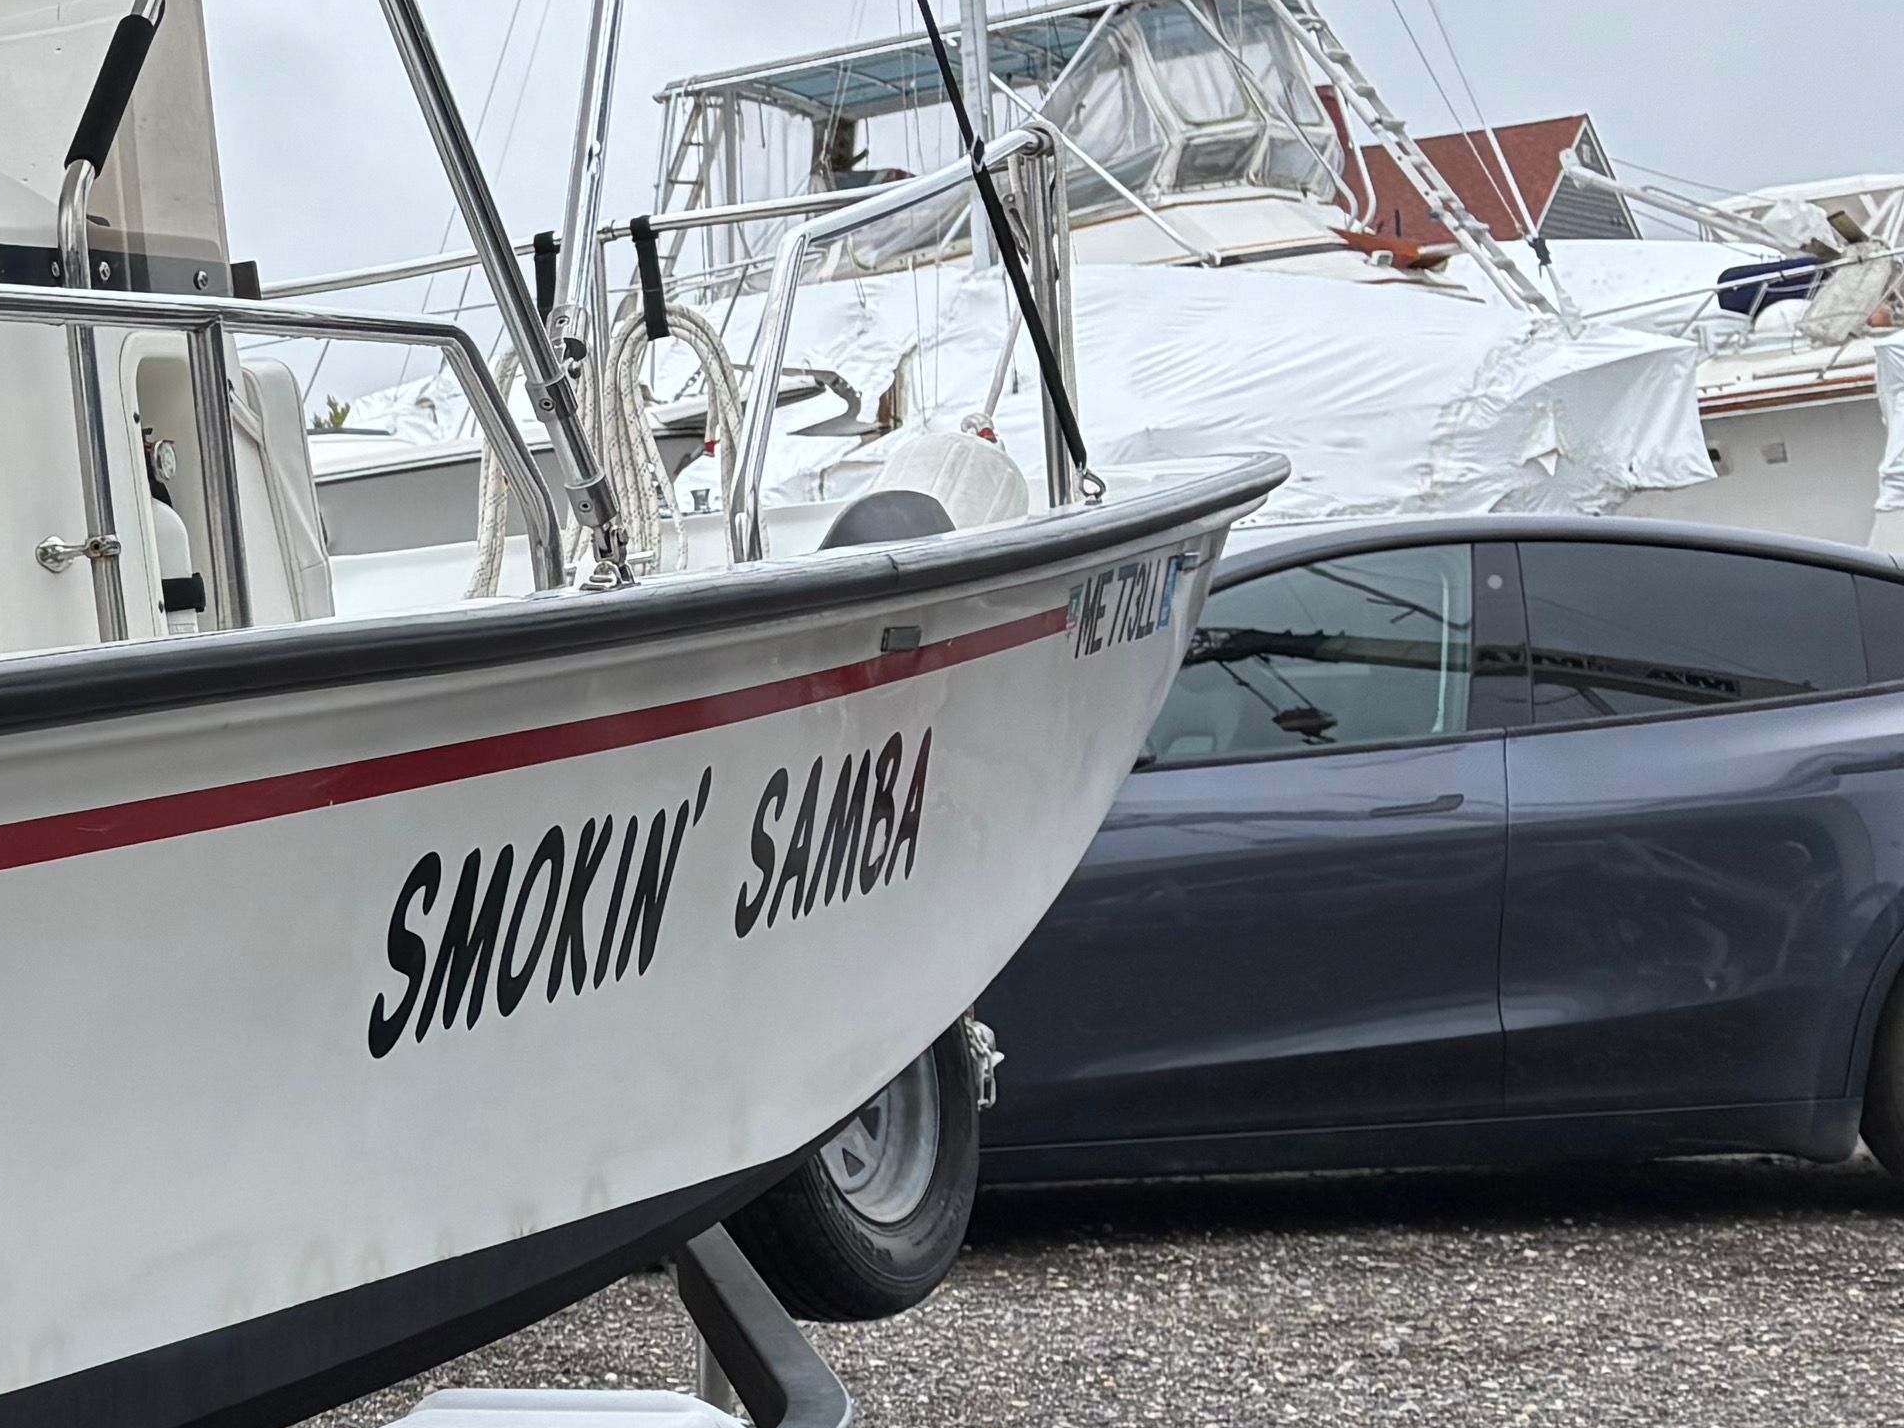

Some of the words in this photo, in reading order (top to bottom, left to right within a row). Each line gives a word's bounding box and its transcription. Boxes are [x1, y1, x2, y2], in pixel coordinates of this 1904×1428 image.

[1074, 569, 1114, 659] ME
[367, 765, 713, 1060] SMOKIN'
[734, 726, 933, 939] SAMBA
